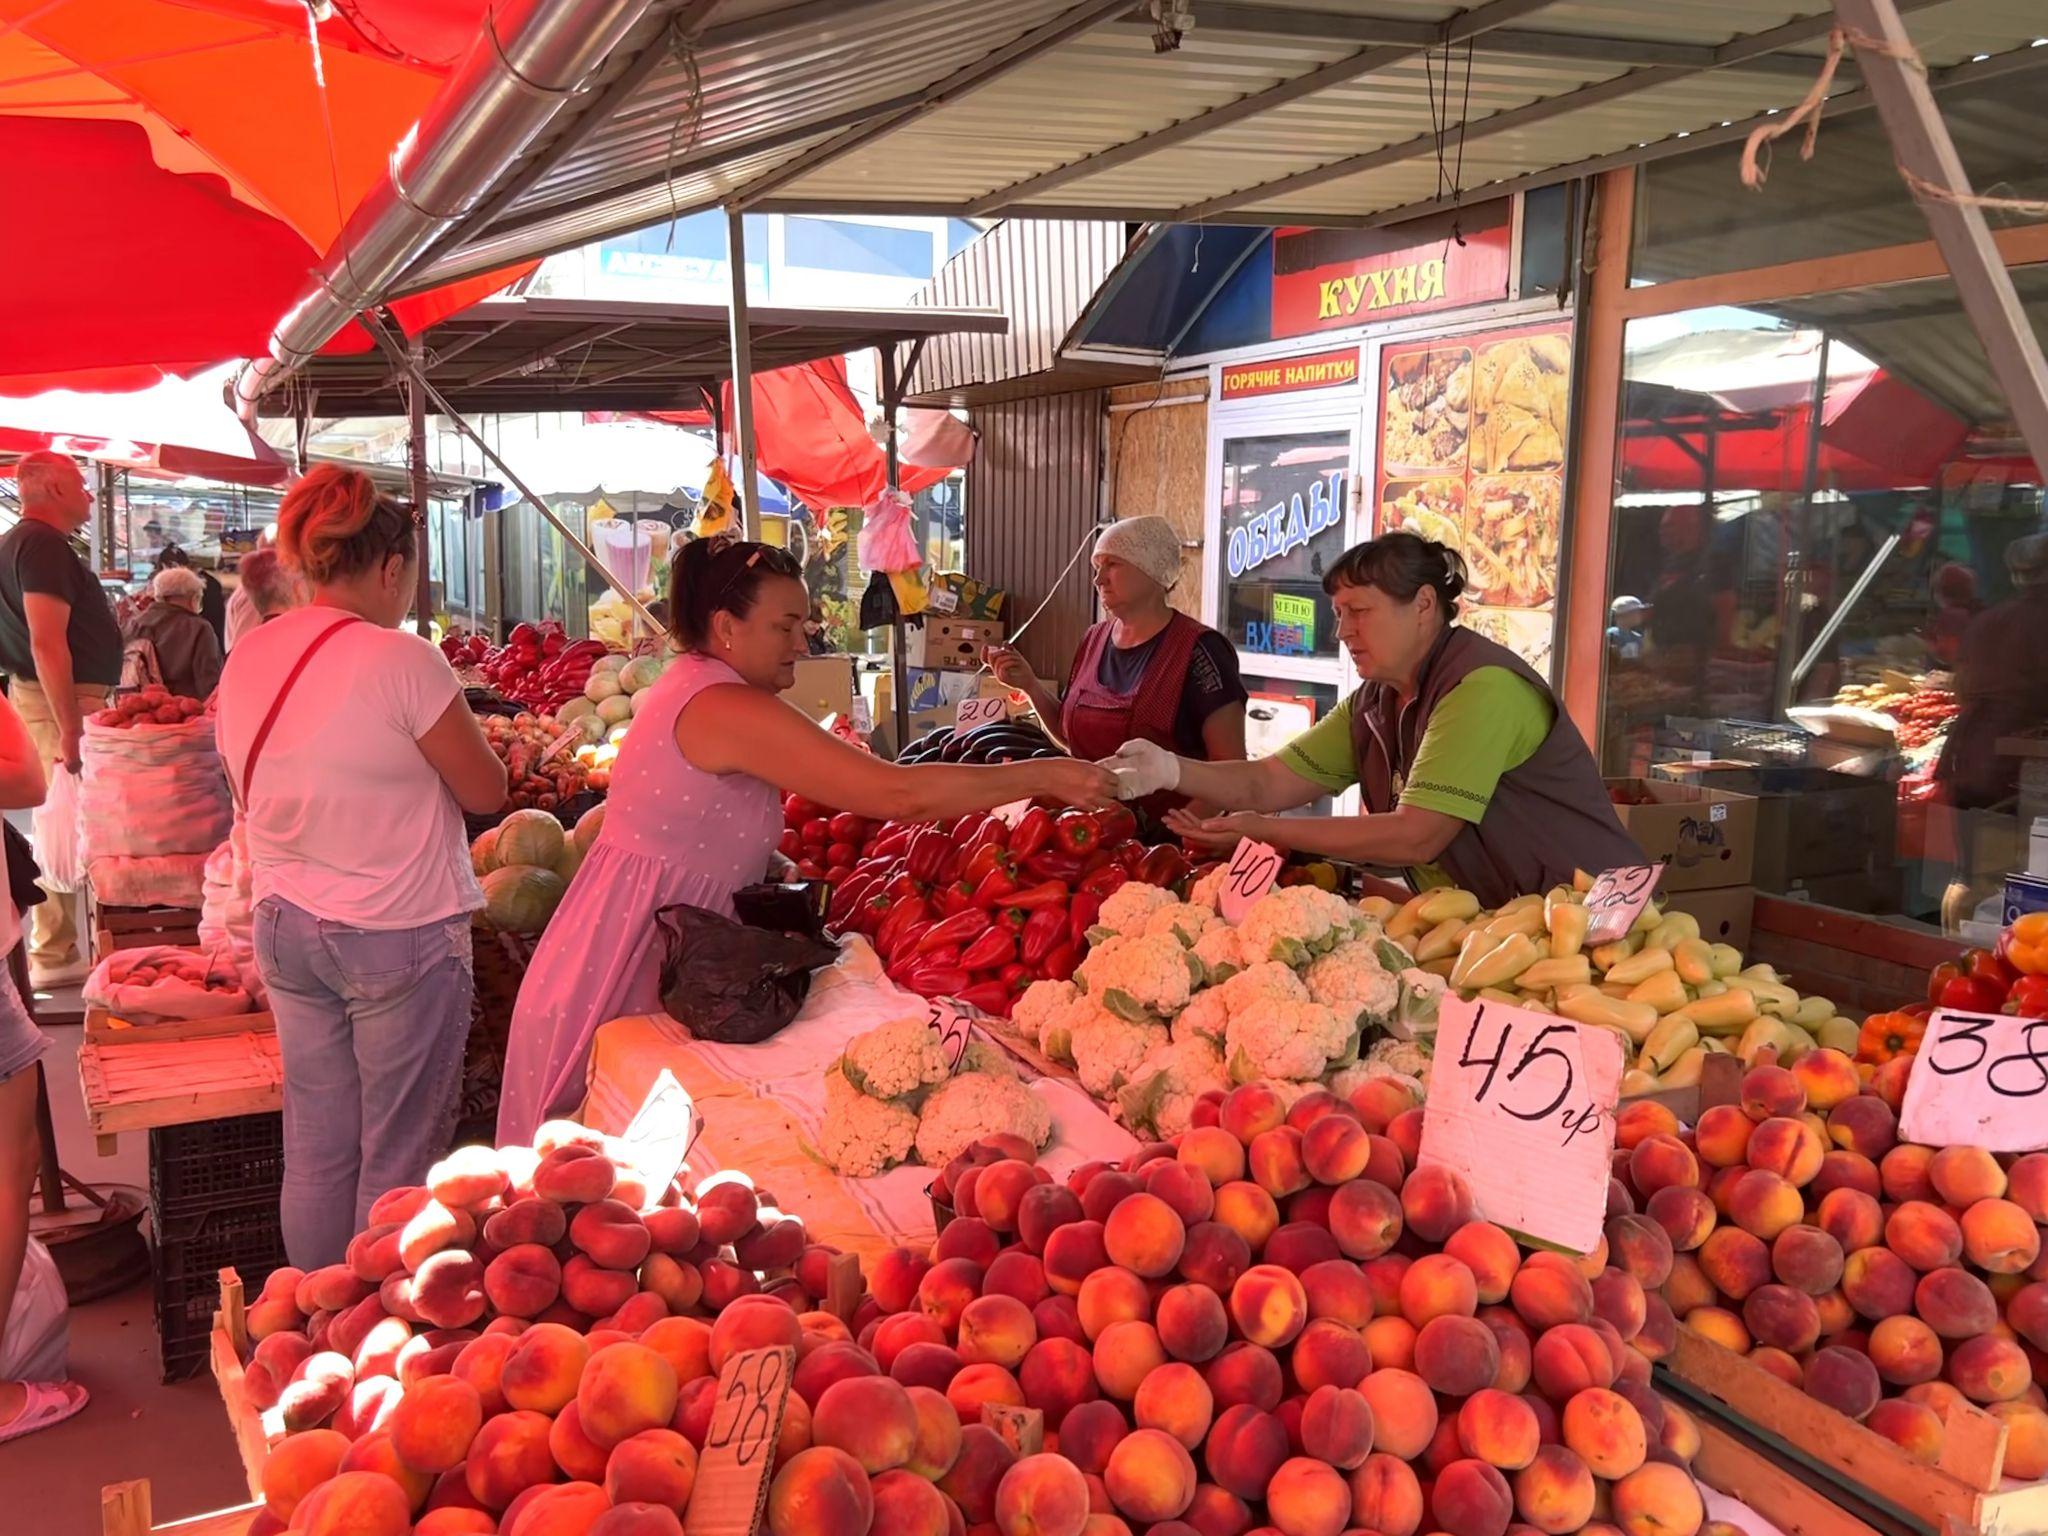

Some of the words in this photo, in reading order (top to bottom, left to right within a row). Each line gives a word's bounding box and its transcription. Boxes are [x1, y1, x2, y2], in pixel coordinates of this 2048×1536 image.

[1318, 258, 1446, 321] КУХНЯ
[1223, 368, 1281, 392] ГОРЯЧИЕ
[1285, 359, 1355, 385] НАПИТКИ
[1228, 470, 1342, 577] ОБЕДЫ
[1274, 600, 1311, 616] МЕНЮ
[958, 698, 1002, 722] 20
[1229, 842, 1276, 897] 40
[1458, 1003, 1577, 1121] 45
[1928, 1015, 2048, 1097] 38
[709, 1350, 782, 1467] 58
